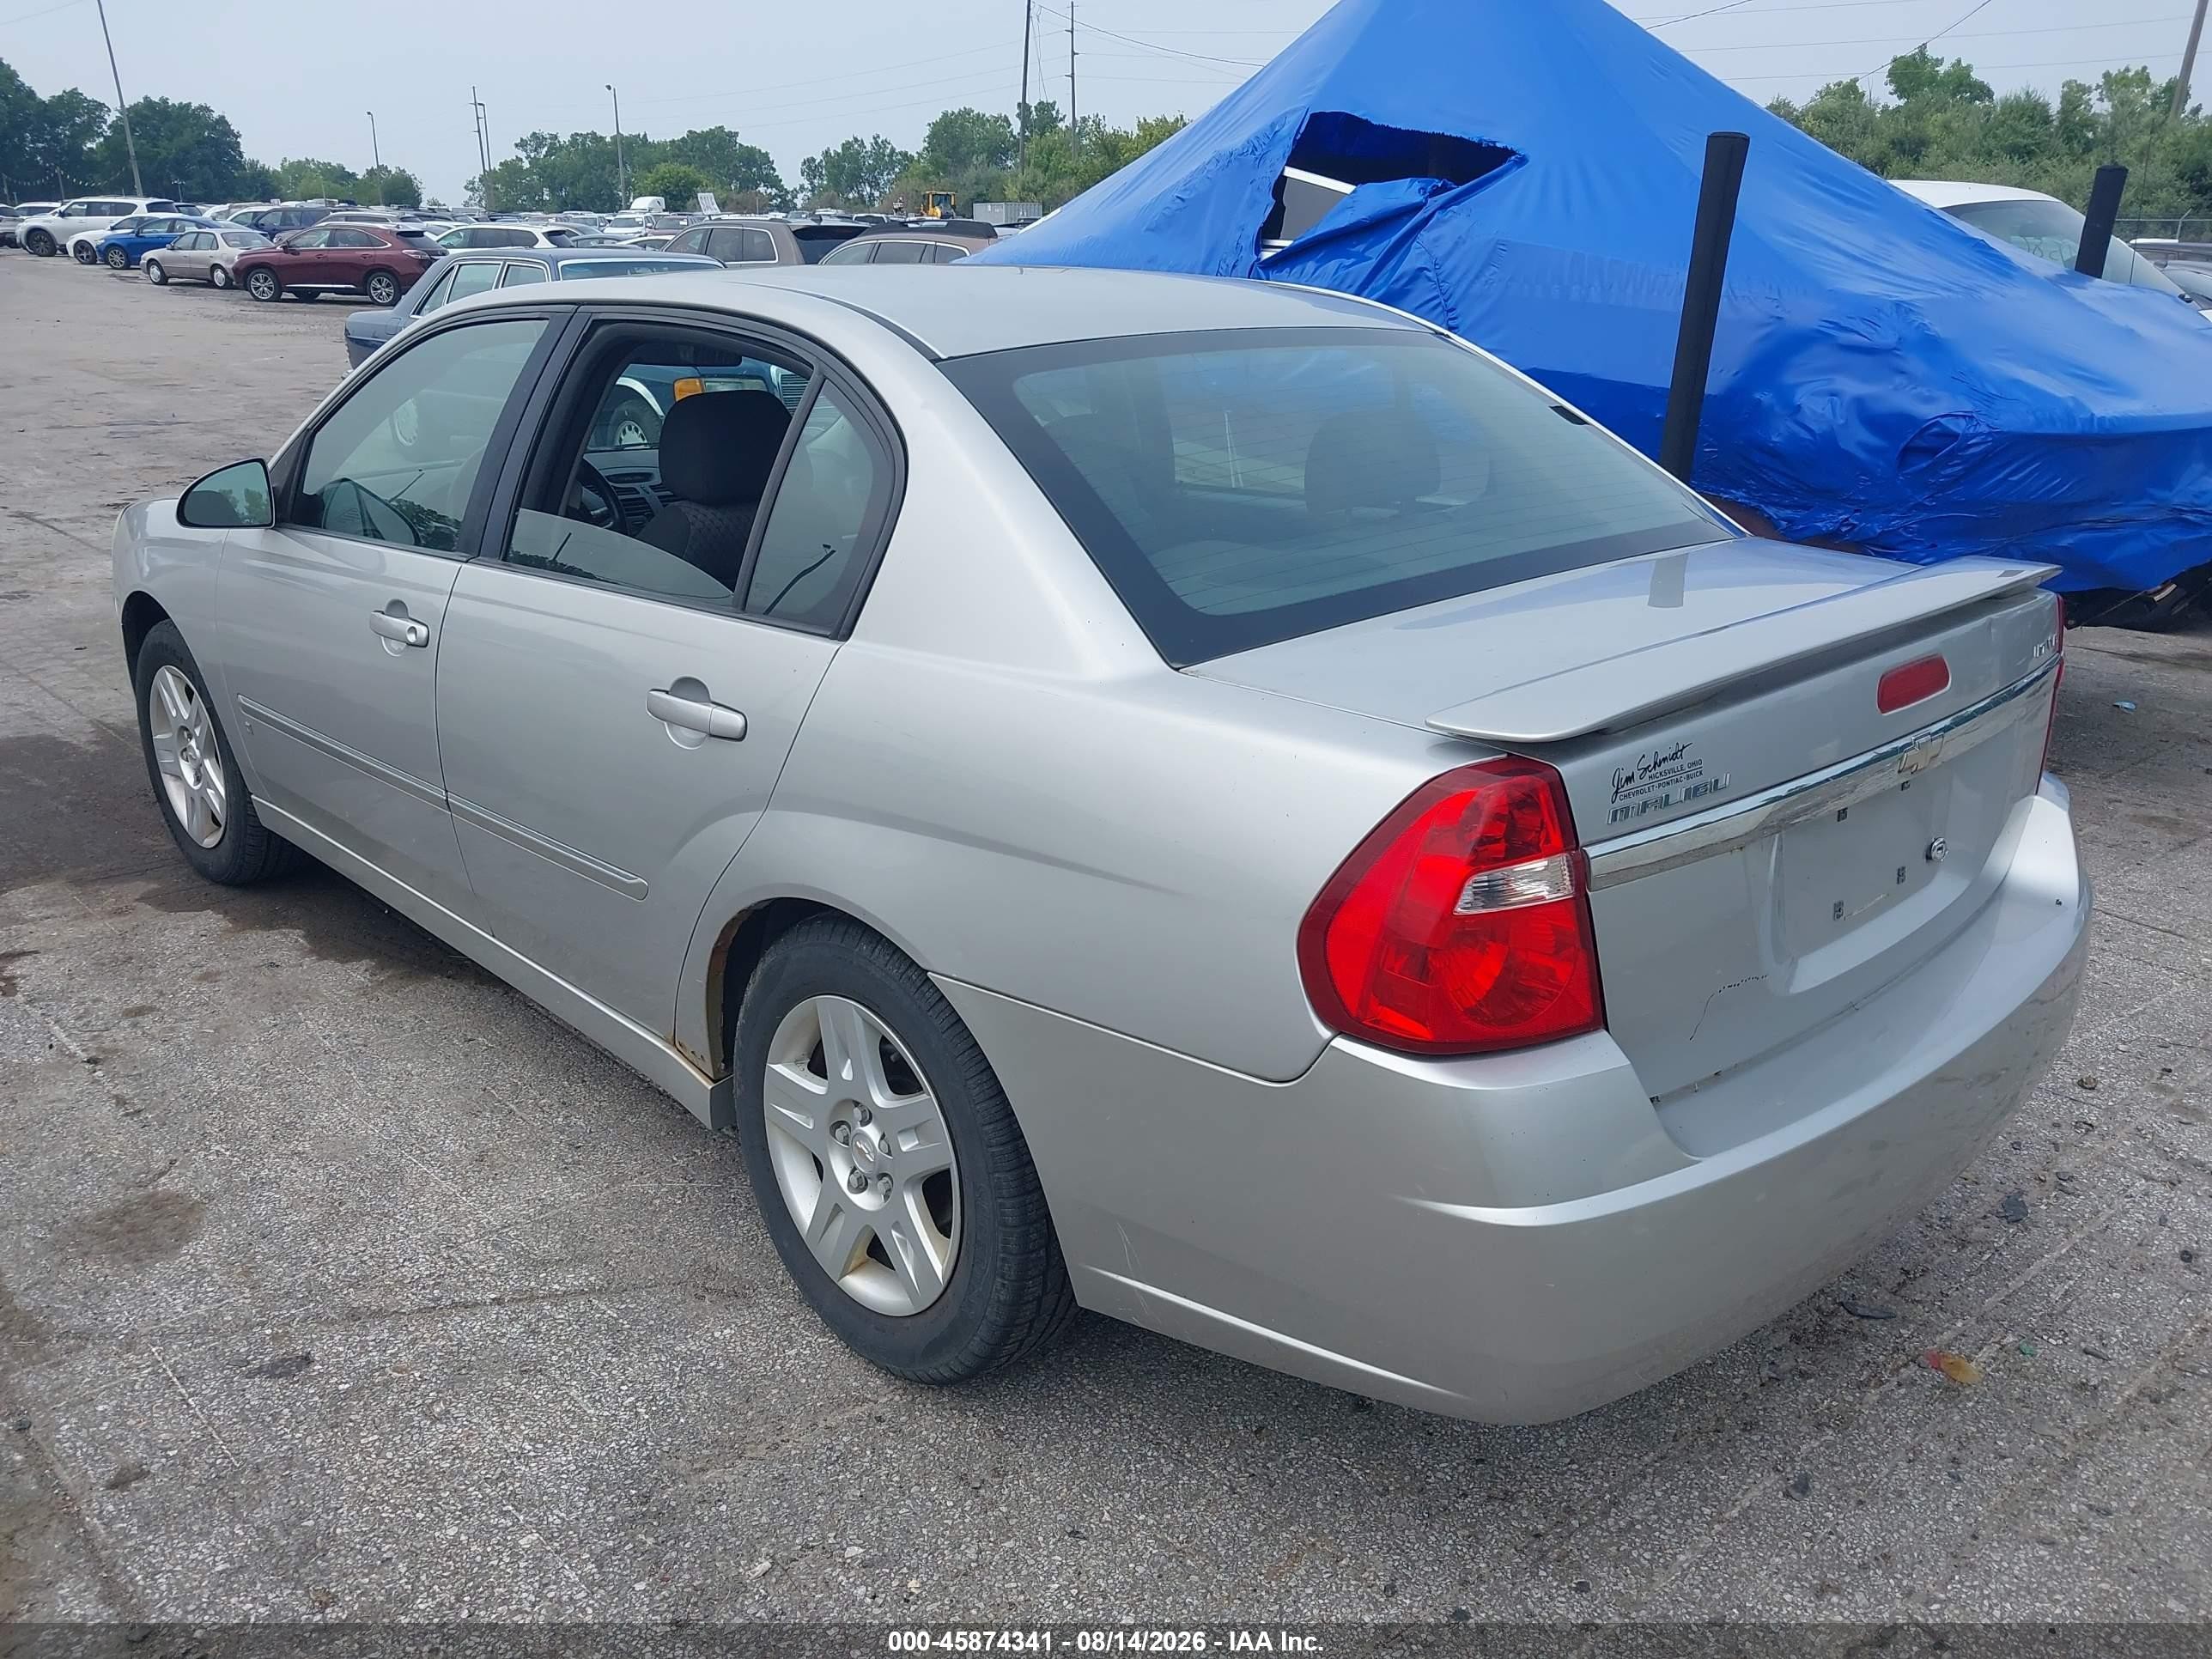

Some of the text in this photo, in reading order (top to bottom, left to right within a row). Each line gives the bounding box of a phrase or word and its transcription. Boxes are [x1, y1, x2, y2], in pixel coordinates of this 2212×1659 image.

[1611, 742, 1693, 804] Jim Schmidt
[1686, 758, 1703, 769] OHIO
[1607, 774, 1730, 824] MALIBU
